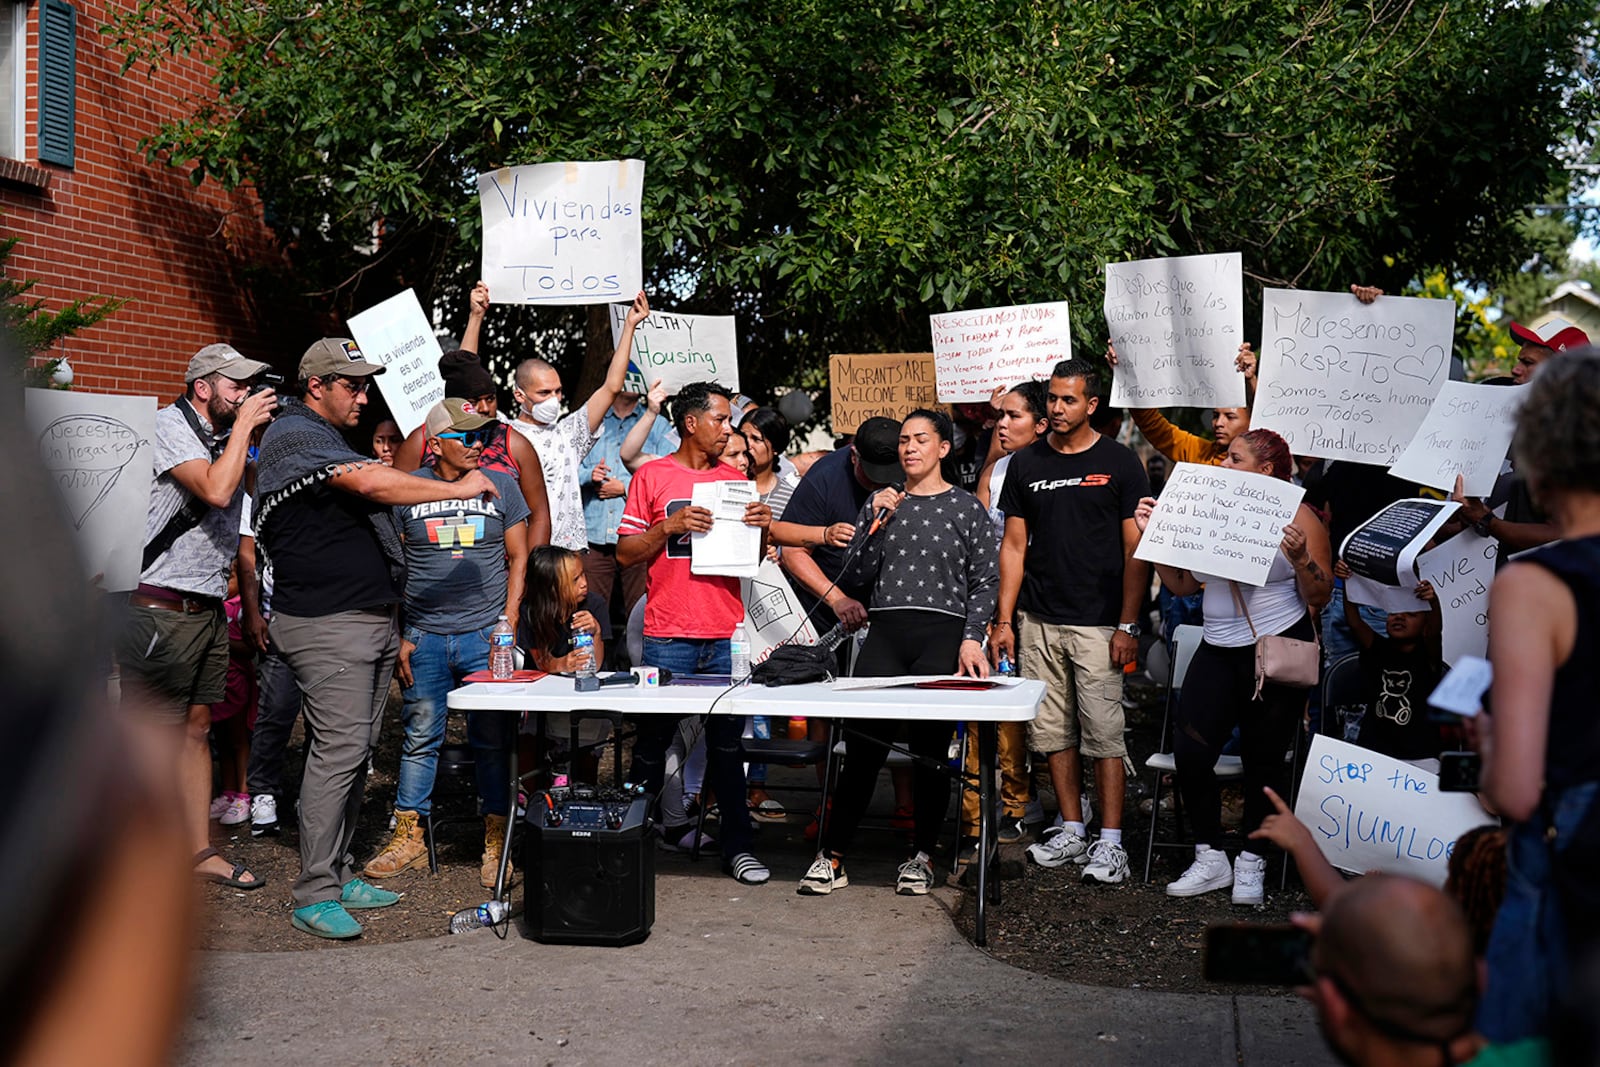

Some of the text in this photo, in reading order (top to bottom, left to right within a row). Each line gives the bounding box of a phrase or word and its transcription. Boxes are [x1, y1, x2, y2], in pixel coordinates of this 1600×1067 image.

[490, 174, 632, 221] Viviendas
[549, 226, 601, 256] para
[503, 265, 620, 292] Todos
[613, 305, 695, 347] HALTHY
[1007, 327, 1013, 337] Y
[1184, 321, 1213, 338] nada
[1273, 302, 1416, 348] Meresemos
[378, 335, 426, 366] La vivienda
[634, 335, 717, 374] Housing
[400, 357, 424, 376] es un
[837, 357, 932, 385] MIGRANTS ARE
[402, 370, 436, 396] derecho
[837, 386, 899, 403] WELCOME
[1268, 380, 1327, 399] Somos
[409, 386, 444, 412] humano
[50, 425, 132, 440] Necesito
[67, 441, 107, 463] hogar
[112, 439, 150, 458] para
[410, 498, 500, 519] VENEZUELA
[1212, 493, 1238, 508] hacer
[1161, 503, 1173, 513] no
[1177, 505, 1187, 515] al
[1236, 516, 1246, 527] ni
[1252, 521, 1261, 530] a
[1149, 532, 1165, 545] Los
[1172, 536, 1205, 551] buenos
[1432, 558, 1475, 588] We
[1388, 769, 1427, 794] the
